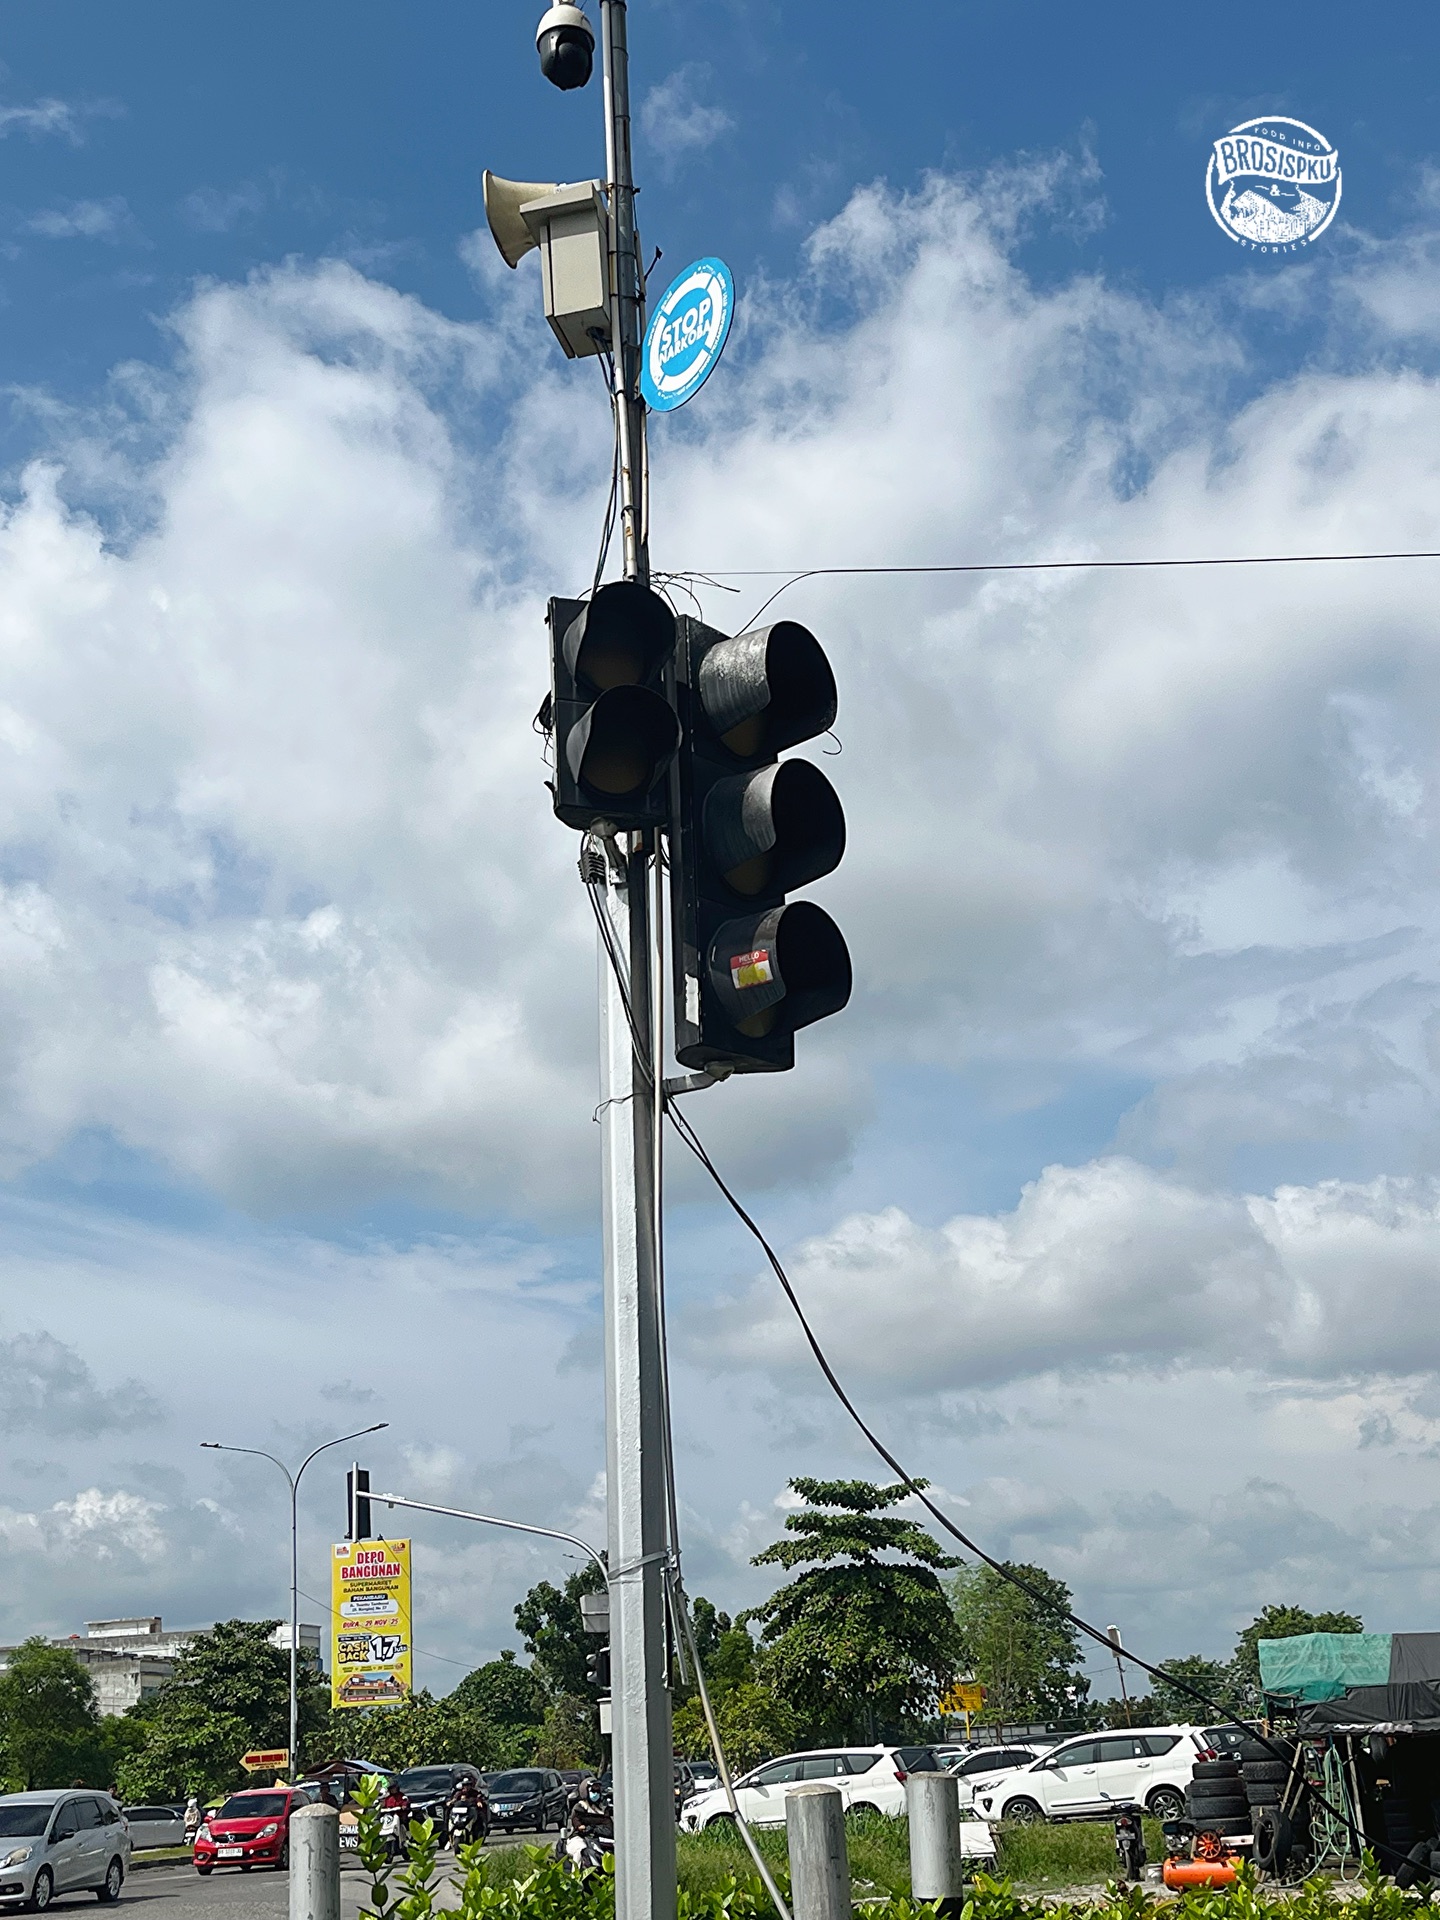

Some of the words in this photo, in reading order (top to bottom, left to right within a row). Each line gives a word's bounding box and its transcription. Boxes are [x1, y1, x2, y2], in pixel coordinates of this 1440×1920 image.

[661, 297, 712, 351] STOP
[658, 319, 712, 366] NARKOBA
[738, 951, 760, 963] HELLO
[357, 1551, 384, 1564] DEPO
[342, 1564, 400, 1578] BANGUNAN
[339, 1641, 368, 1652] CASH
[338, 1651, 368, 1663] BACK
[339, 1836, 359, 1848] EVIS
